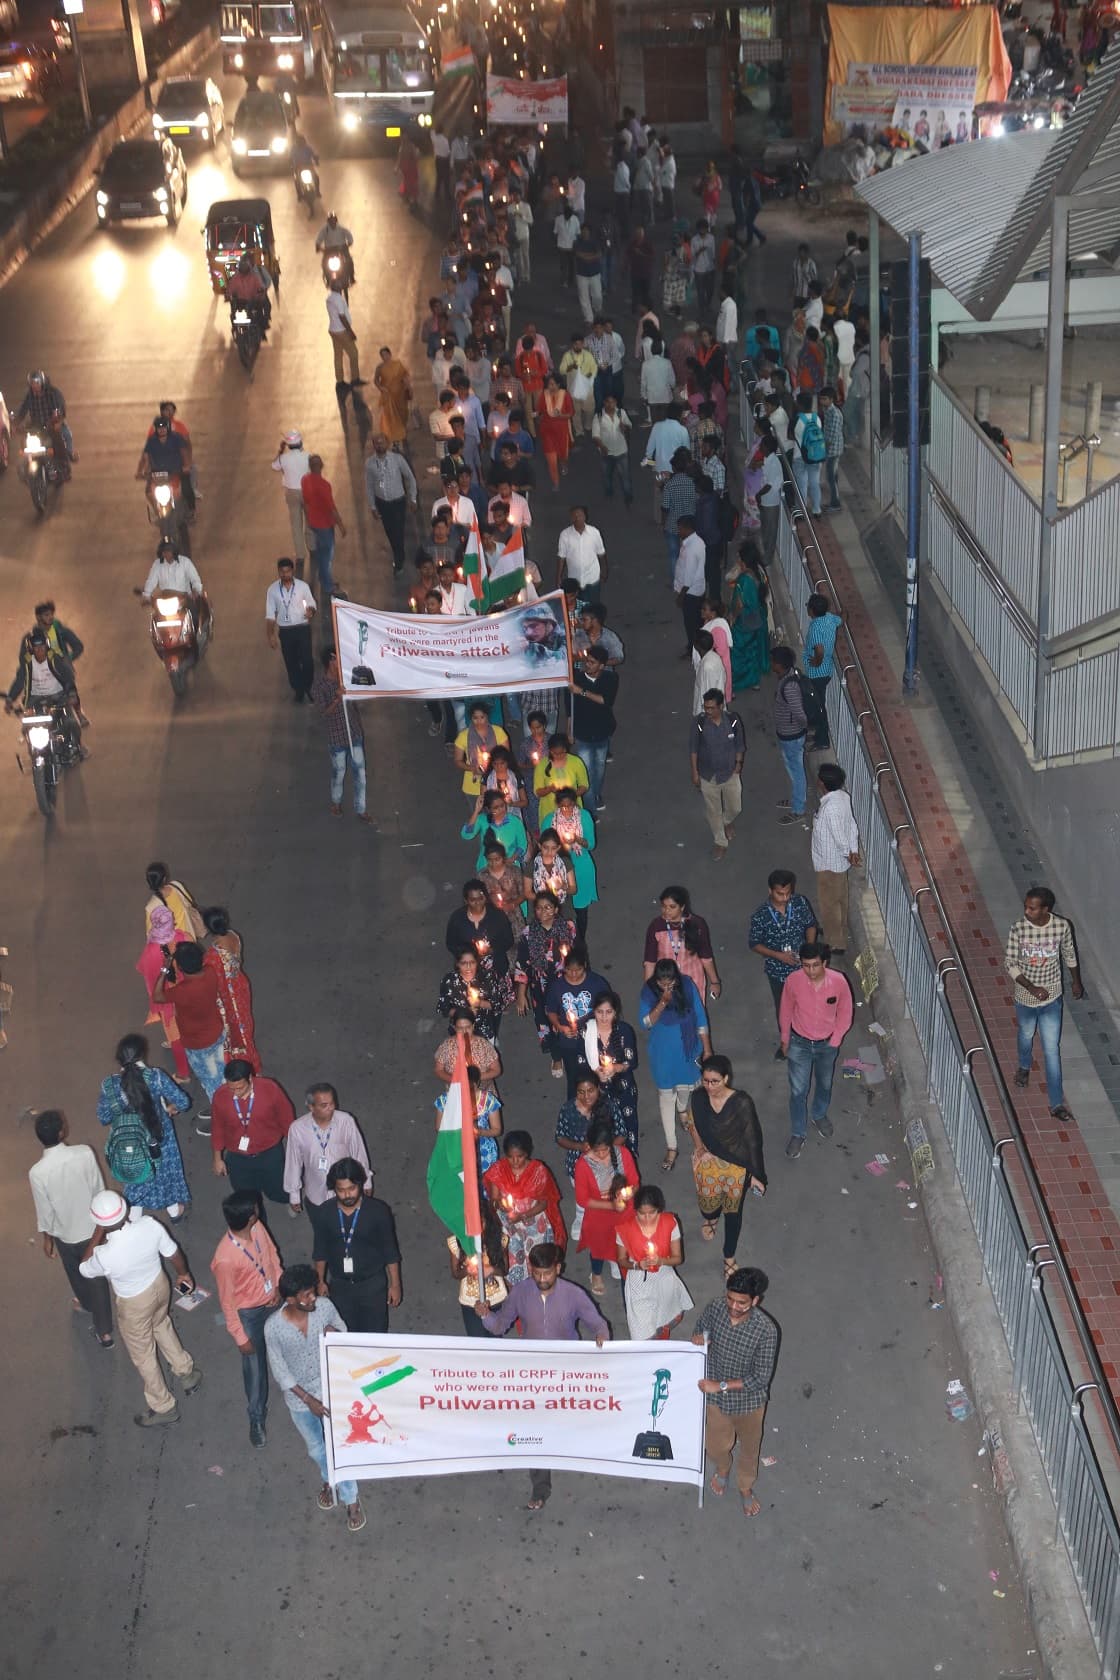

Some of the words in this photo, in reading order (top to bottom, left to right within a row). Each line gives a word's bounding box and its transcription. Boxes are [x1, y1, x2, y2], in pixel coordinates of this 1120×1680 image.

[385, 626, 416, 635] Tribute
[432, 635, 472, 646] martyred
[485, 633, 499, 641] the
[461, 643, 510, 657] attack
[431, 1368, 478, 1379] Tribute
[481, 1369, 495, 1379] to
[499, 1369, 515, 1379] all
[519, 1369, 558, 1379] CRPF
[561, 1369, 609, 1381] jawans
[434, 1382, 463, 1392] who
[466, 1383, 499, 1392] were
[503, 1383, 564, 1394] martyred
[568, 1383, 581, 1392] in
[585, 1384, 606, 1393] the
[419, 1395, 536, 1411] Pulwama
[544, 1395, 623, 1411] attack
